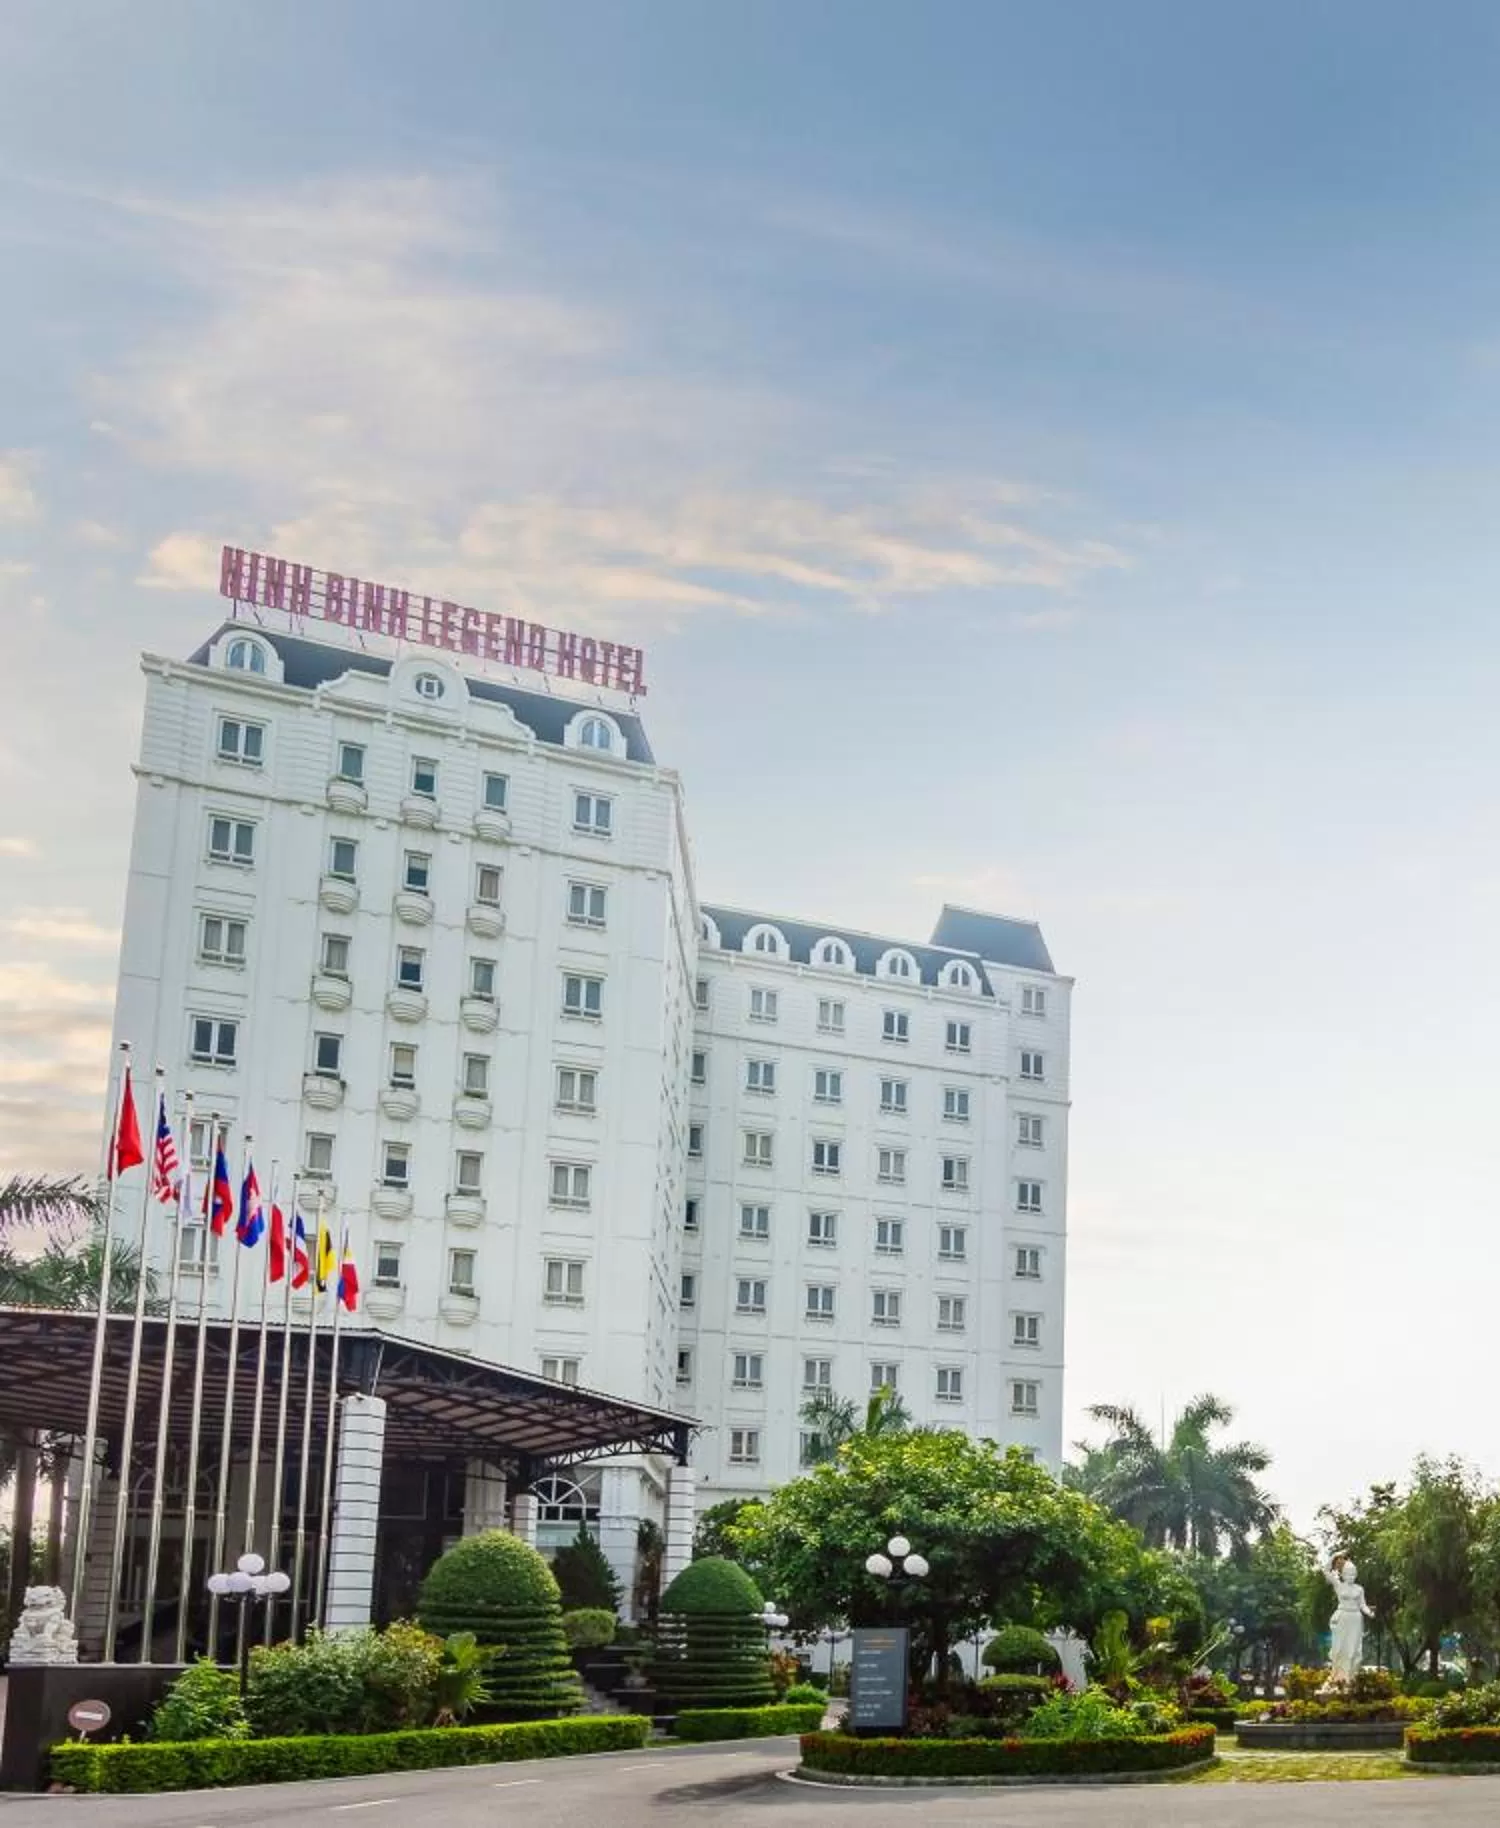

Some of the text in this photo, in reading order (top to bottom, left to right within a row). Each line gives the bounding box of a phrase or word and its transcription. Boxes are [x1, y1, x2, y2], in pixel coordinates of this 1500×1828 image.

[220, 545, 647, 696] NINH BINH LEGEND HOTEL
